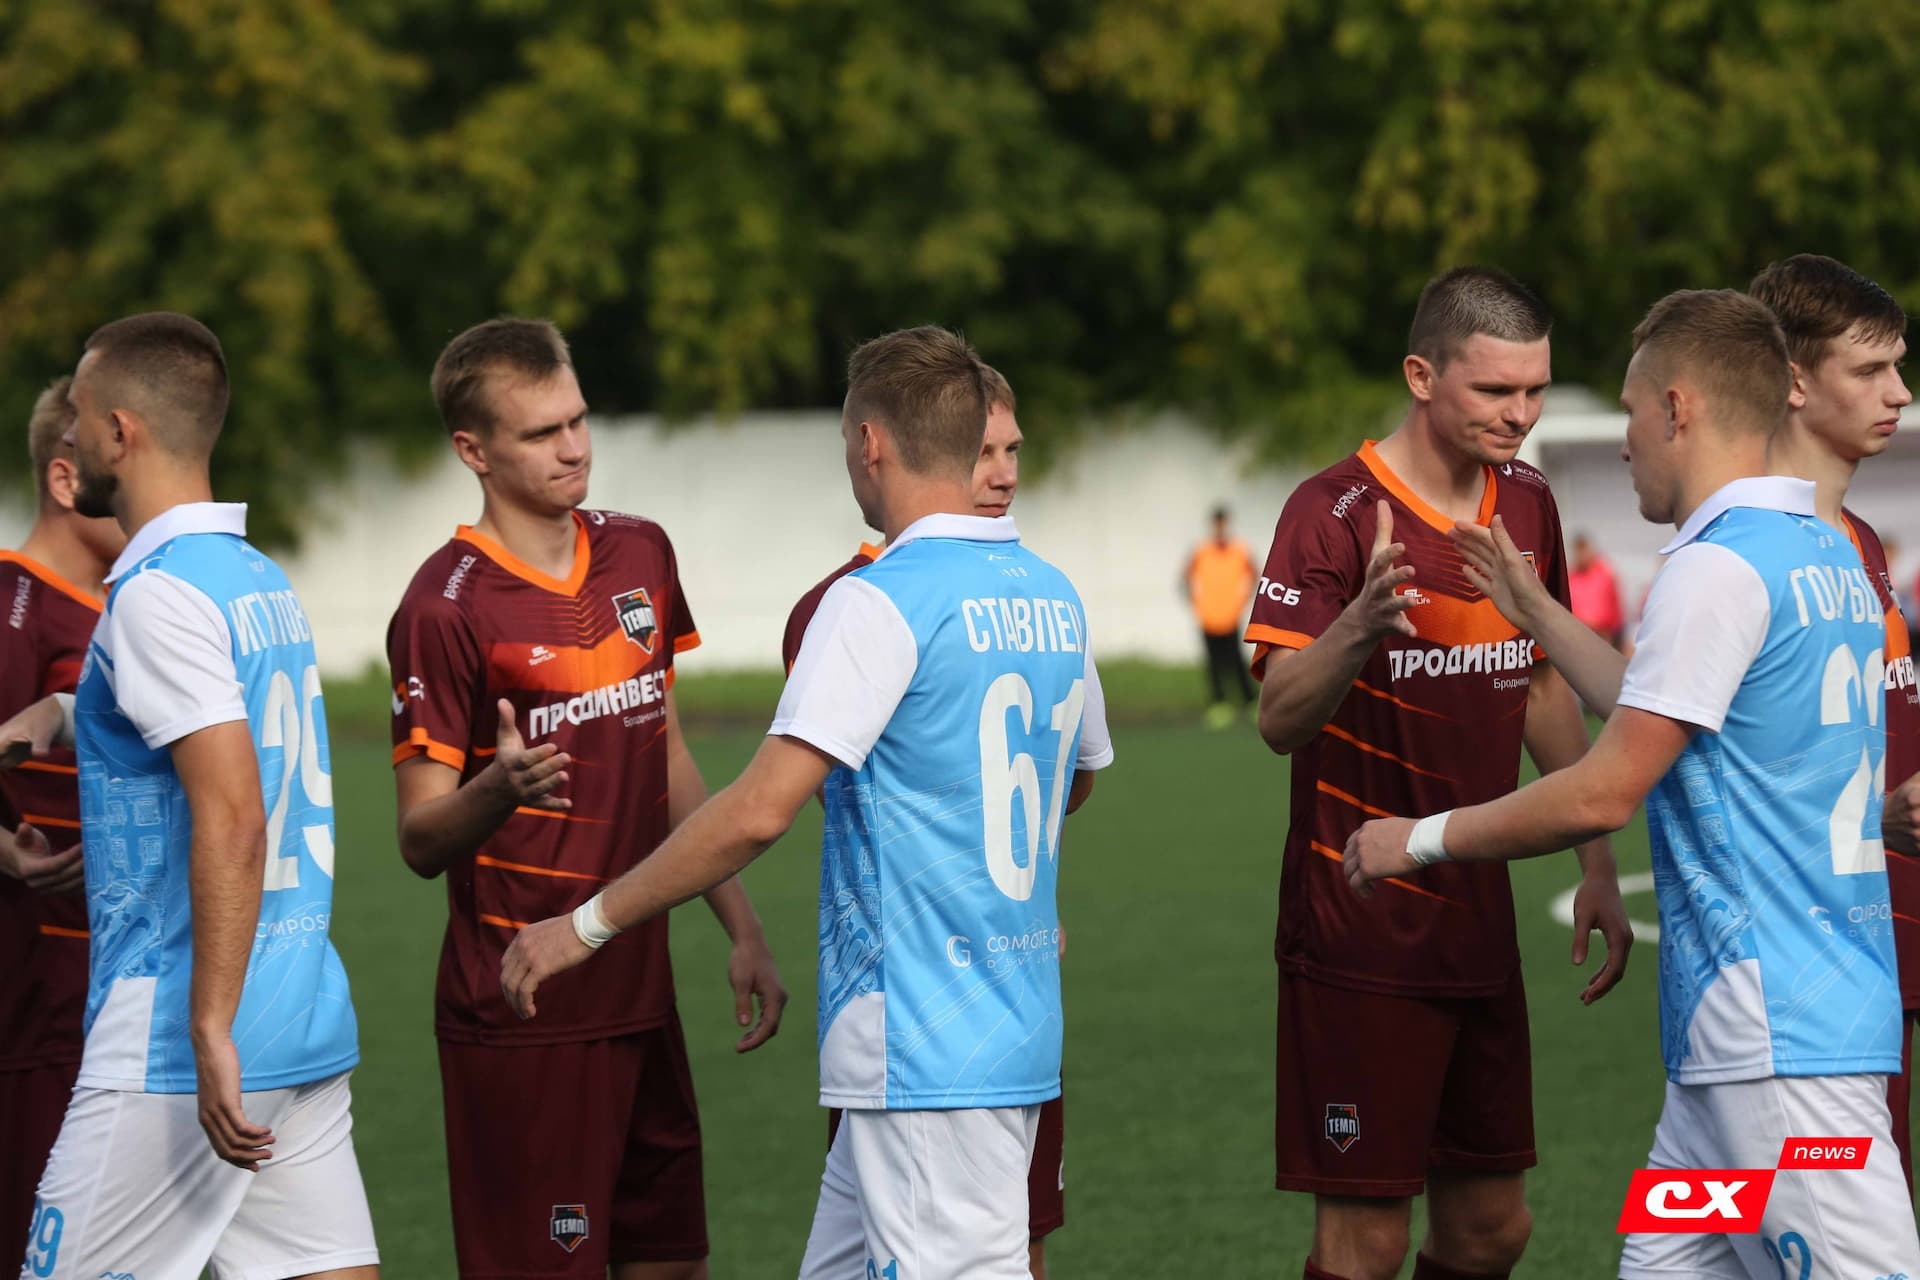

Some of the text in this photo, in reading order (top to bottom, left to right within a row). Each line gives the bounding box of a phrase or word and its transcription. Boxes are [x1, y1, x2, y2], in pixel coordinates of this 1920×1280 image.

[261, 665, 335, 891] 29
[979, 672, 1085, 901] 61
[1328, 1117, 1357, 1135] ТЕМП
[554, 1218, 585, 1235] ТЕМП
